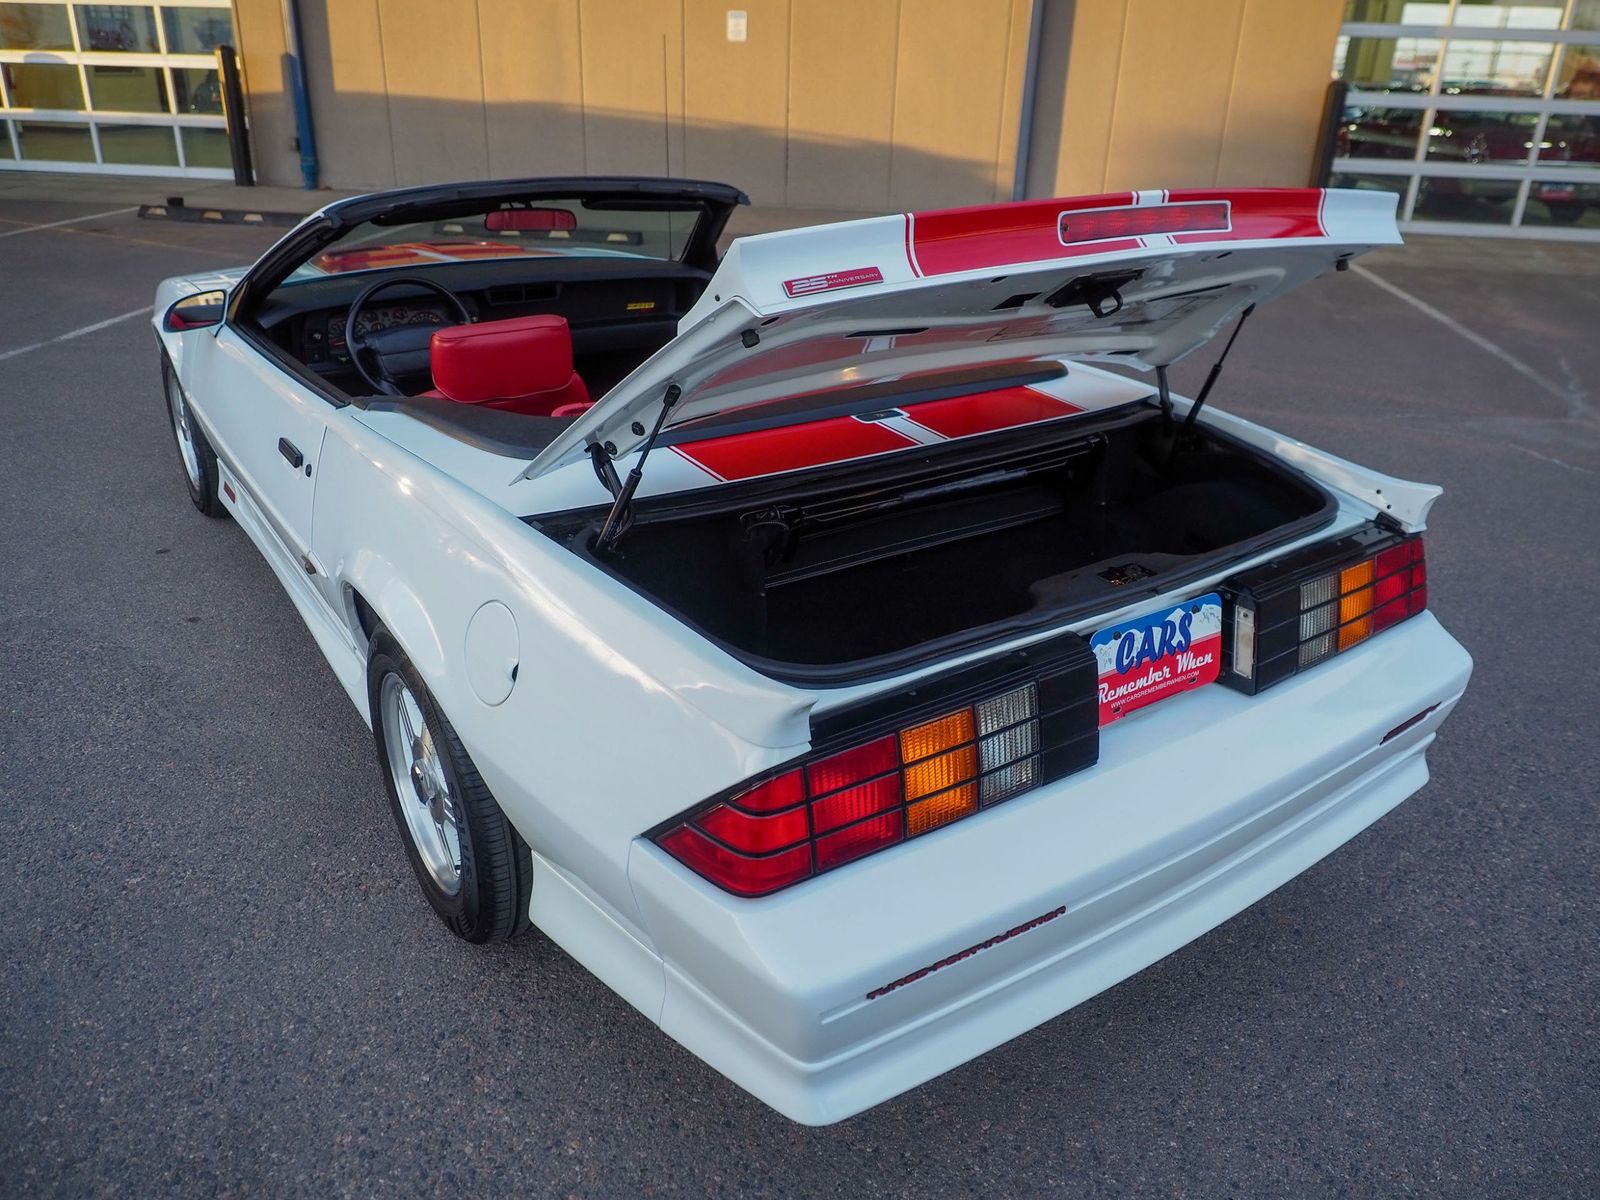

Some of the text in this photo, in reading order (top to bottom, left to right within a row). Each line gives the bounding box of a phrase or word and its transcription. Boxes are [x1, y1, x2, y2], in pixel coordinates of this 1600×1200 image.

[829, 273, 878, 284] ANNIVERSARY
[1115, 612, 1193, 675] CARS
[1098, 650, 1214, 705] Remember When
[1110, 670, 1200, 709] WWW.CARSREMEMBERWHEN.COM
